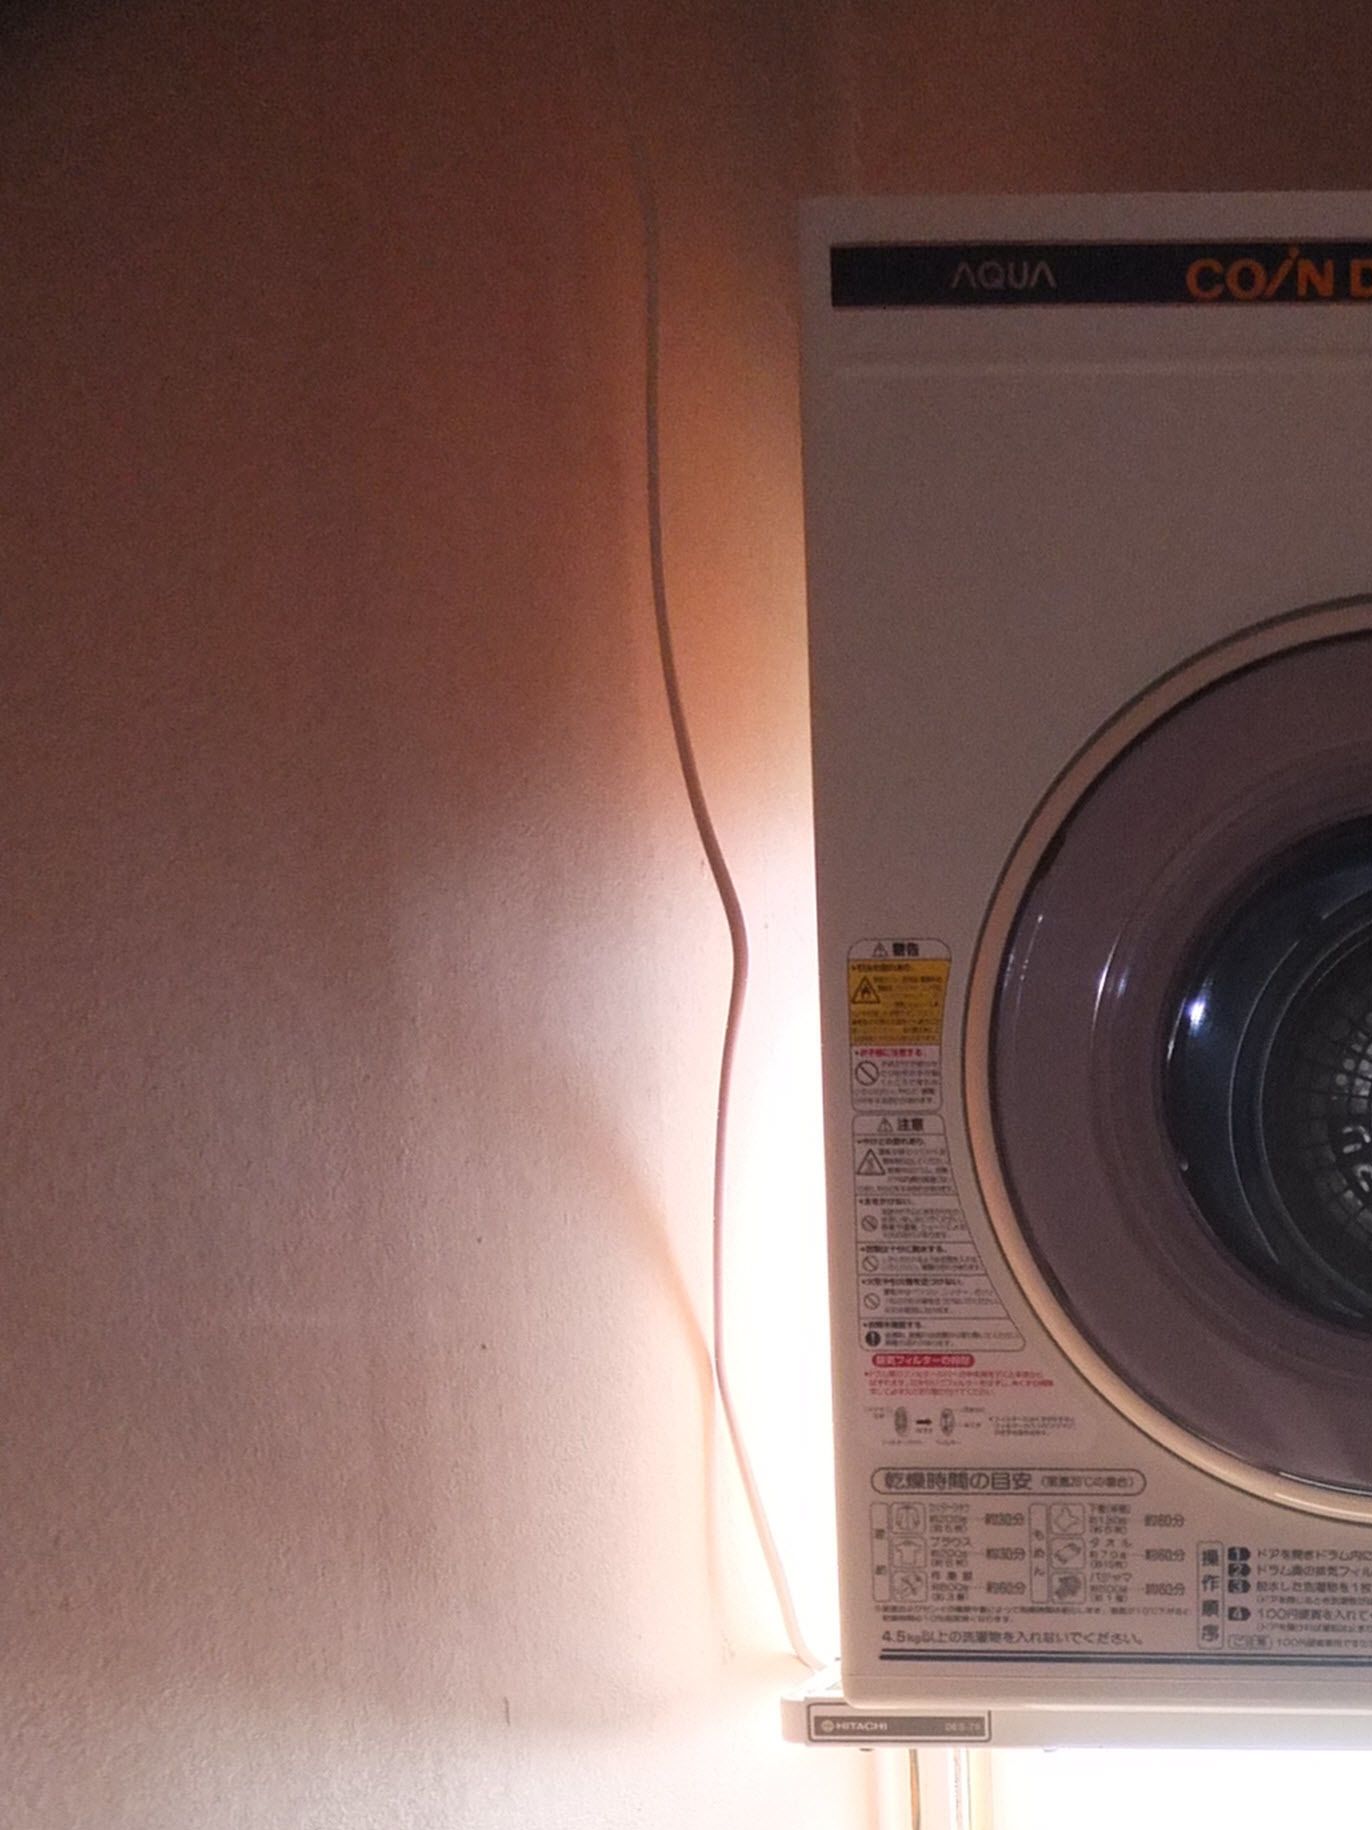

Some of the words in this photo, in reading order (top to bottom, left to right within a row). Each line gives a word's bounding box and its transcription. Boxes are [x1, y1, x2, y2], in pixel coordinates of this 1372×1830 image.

[952, 261, 1056, 289] AQUA
[898, 1117, 924, 1131] 注意
[885, 1471, 1032, 1491] 乾燥時間の目安
[836, 1721, 888, 1732] HITACHI
